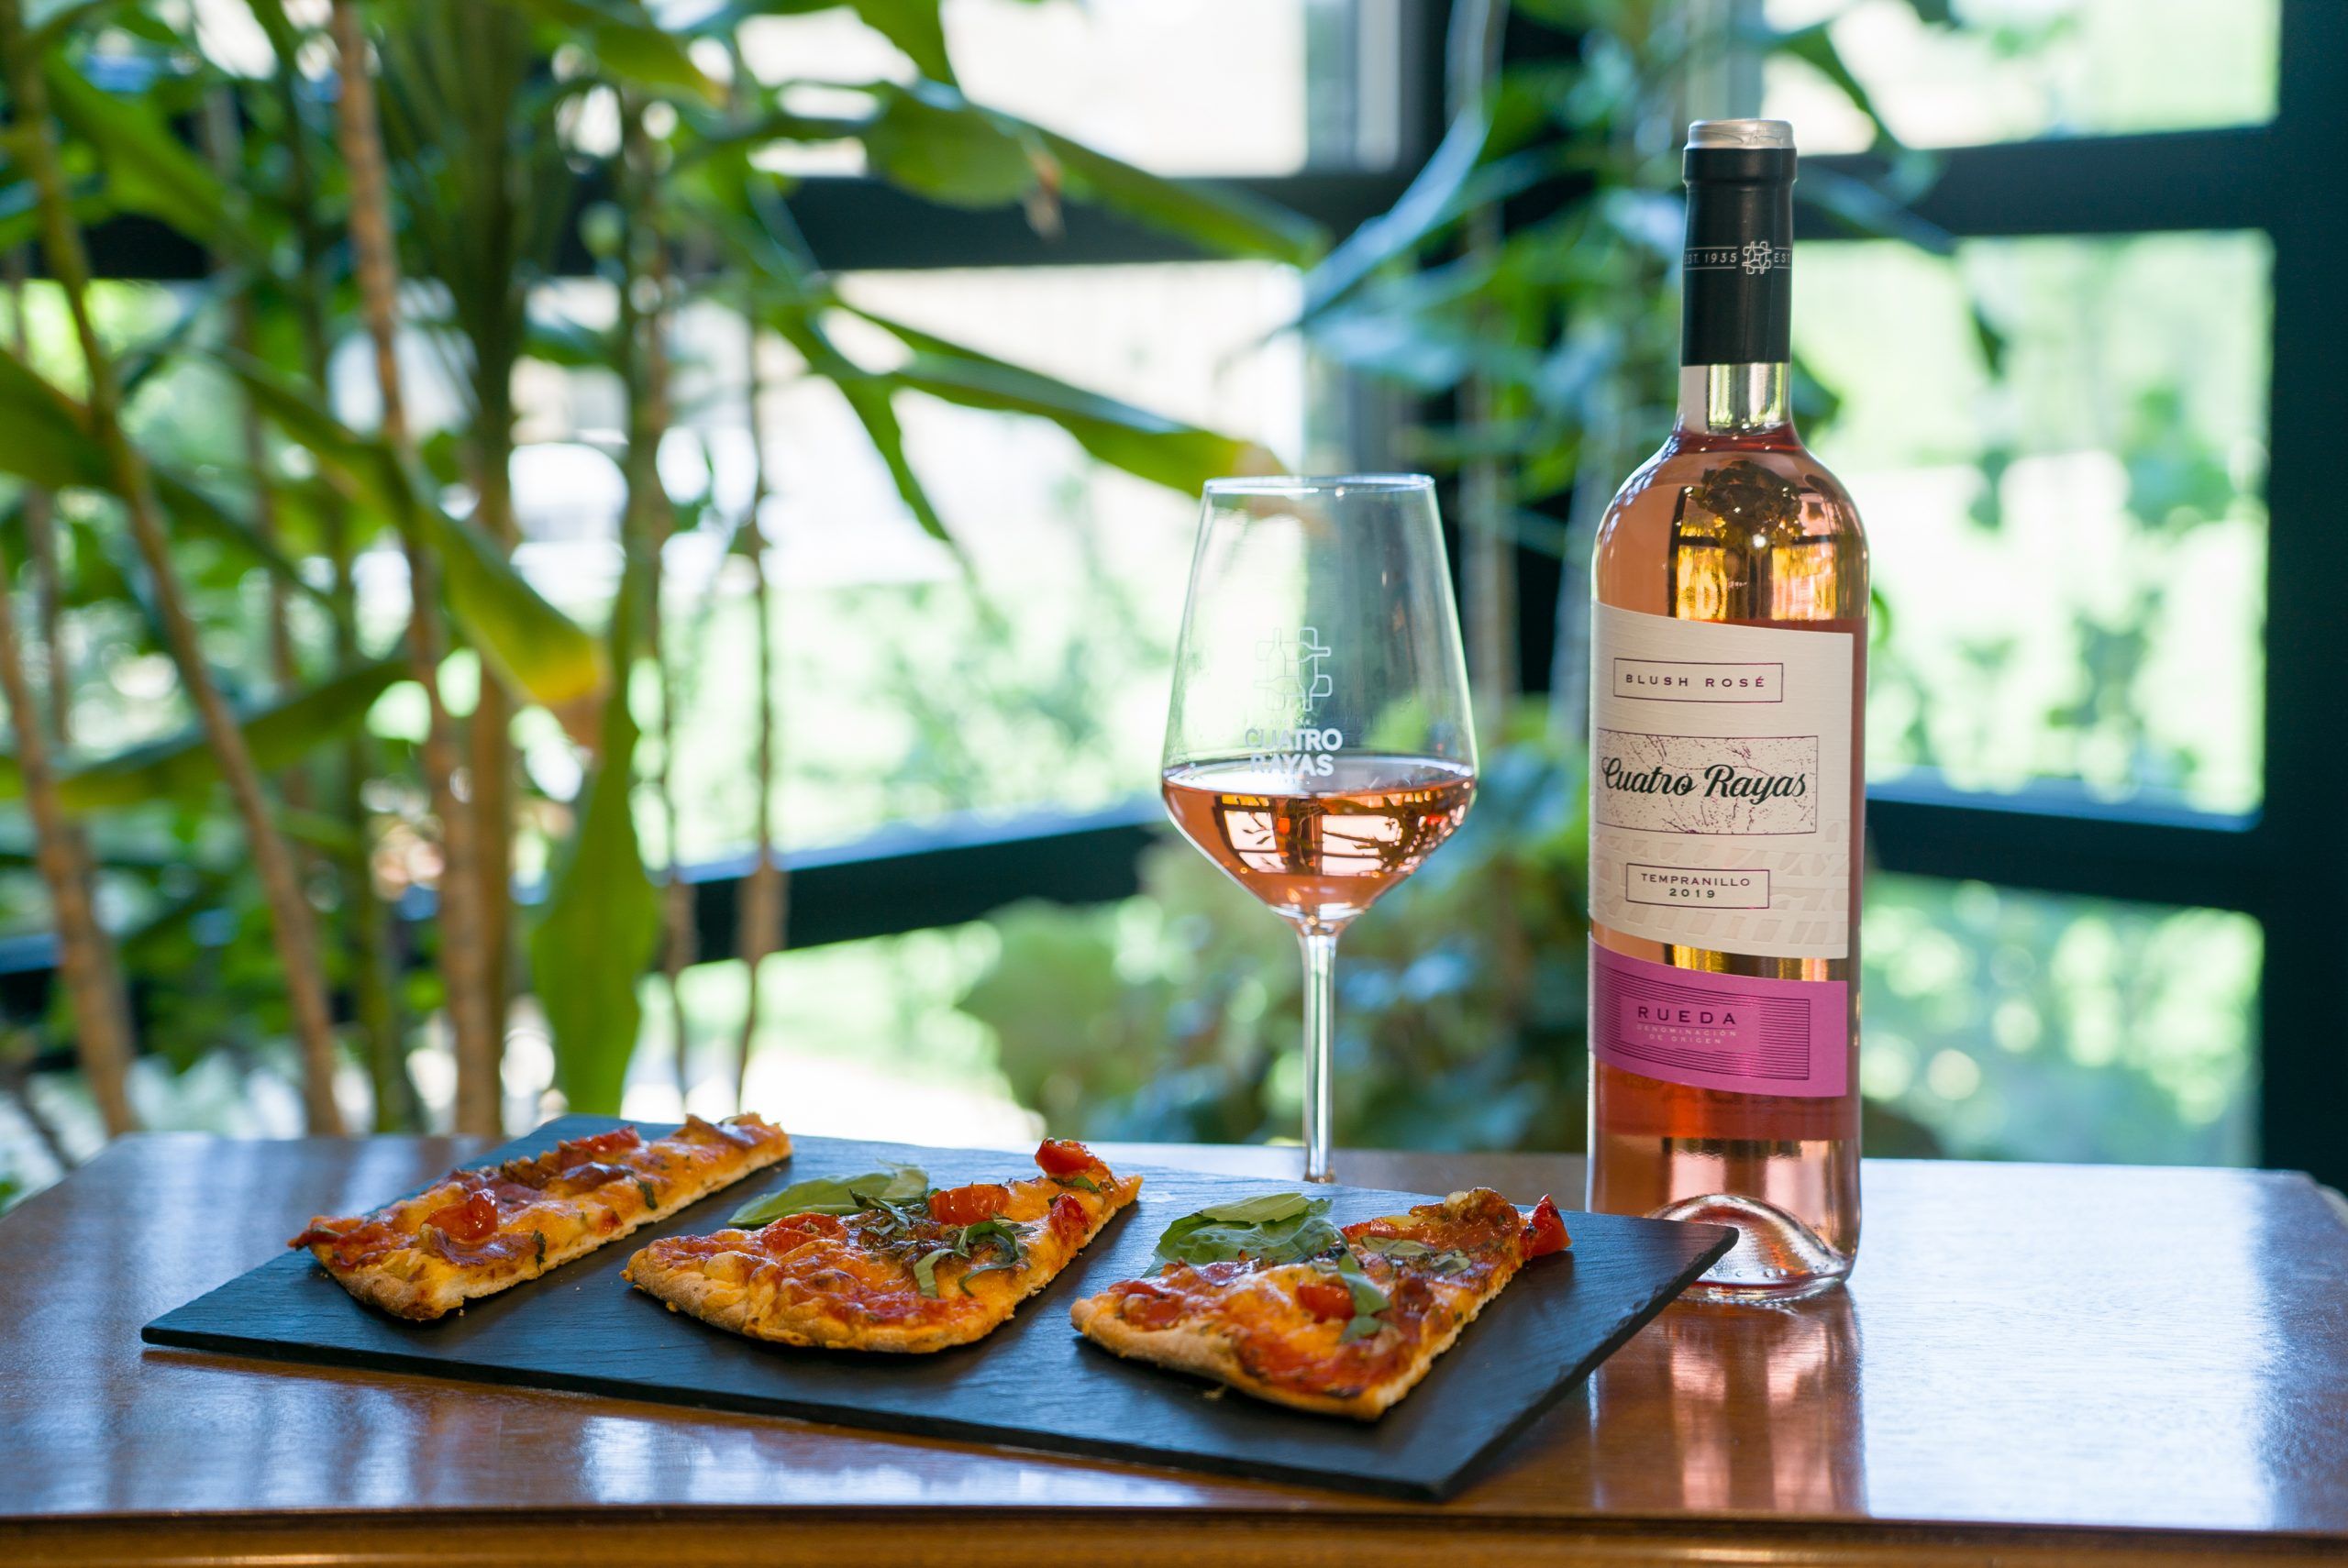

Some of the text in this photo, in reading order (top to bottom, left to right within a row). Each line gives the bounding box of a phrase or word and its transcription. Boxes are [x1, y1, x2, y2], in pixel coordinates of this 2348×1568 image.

[1704, 252, 1737, 264] 1935
[1625, 673, 1766, 688] BLUSH ROSÉ
[1246, 728, 1343, 751] CUATRO
[1250, 754, 1335, 777] RAYAS
[1600, 756, 1807, 805] Cuatro Rayas
[1640, 872, 1751, 887] TEMPRANILLO
[1667, 888, 1716, 899] 2019
[1637, 1005, 1737, 1025] RUEDA
[1636, 1024, 1737, 1037] DENOMINACIÓN
[1648, 1033, 1722, 1045] DE ORIGEN
